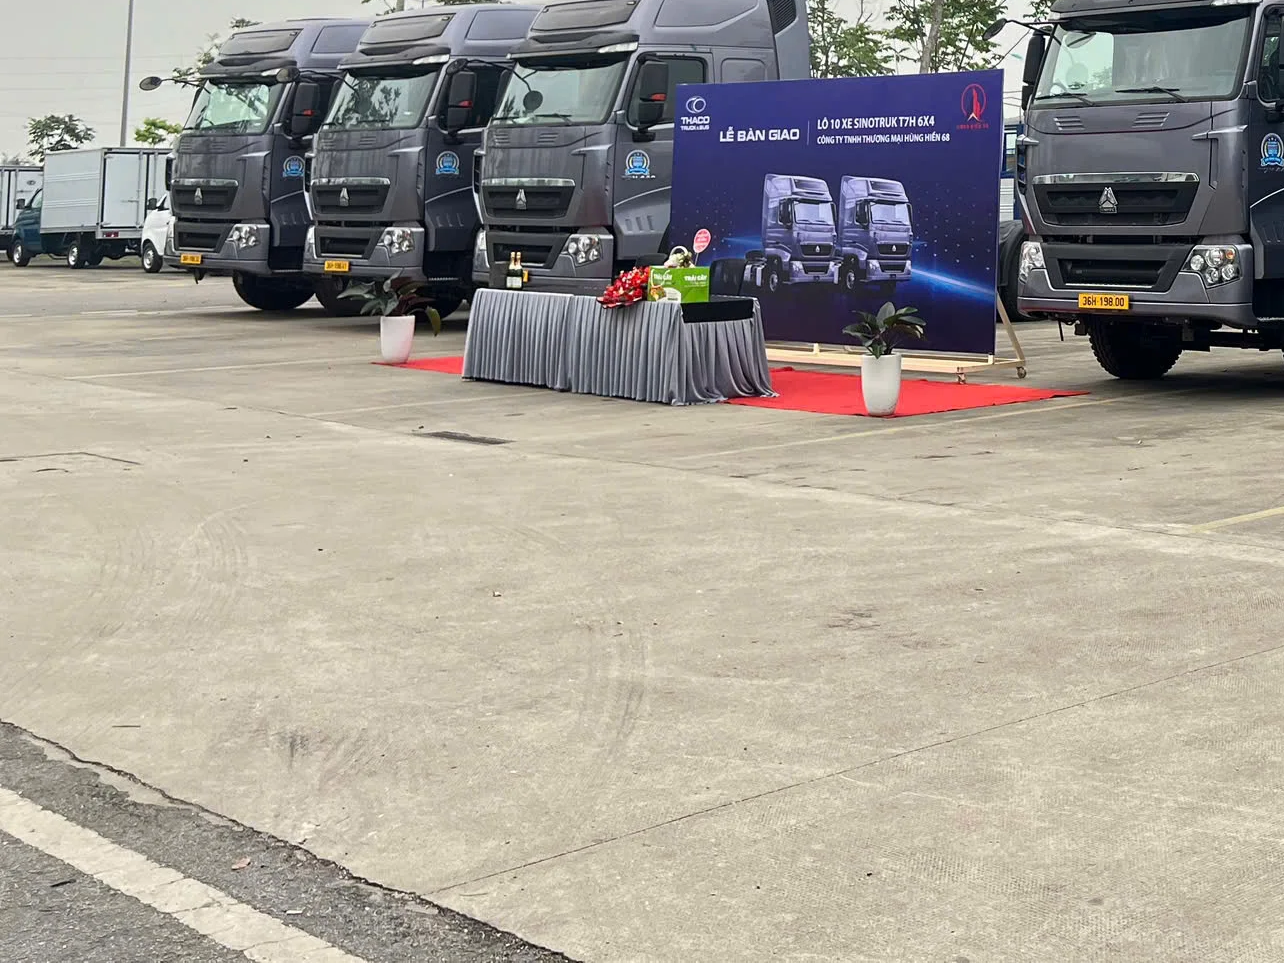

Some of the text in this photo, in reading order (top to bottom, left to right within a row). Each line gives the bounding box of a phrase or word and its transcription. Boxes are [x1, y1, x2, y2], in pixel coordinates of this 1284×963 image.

[680, 116, 710, 124] THACO
[817, 116, 935, 130] LÔ 10 XE SINOTRUK T7H 6X4
[719, 126, 800, 142] LỄ BÀN GIAO
[817, 134, 835, 144] CÔNG
[835, 135, 844, 144] TY
[844, 135, 862, 144] TNHH
[890, 134, 904, 145] MẠI
[941, 133, 950, 142] 68
